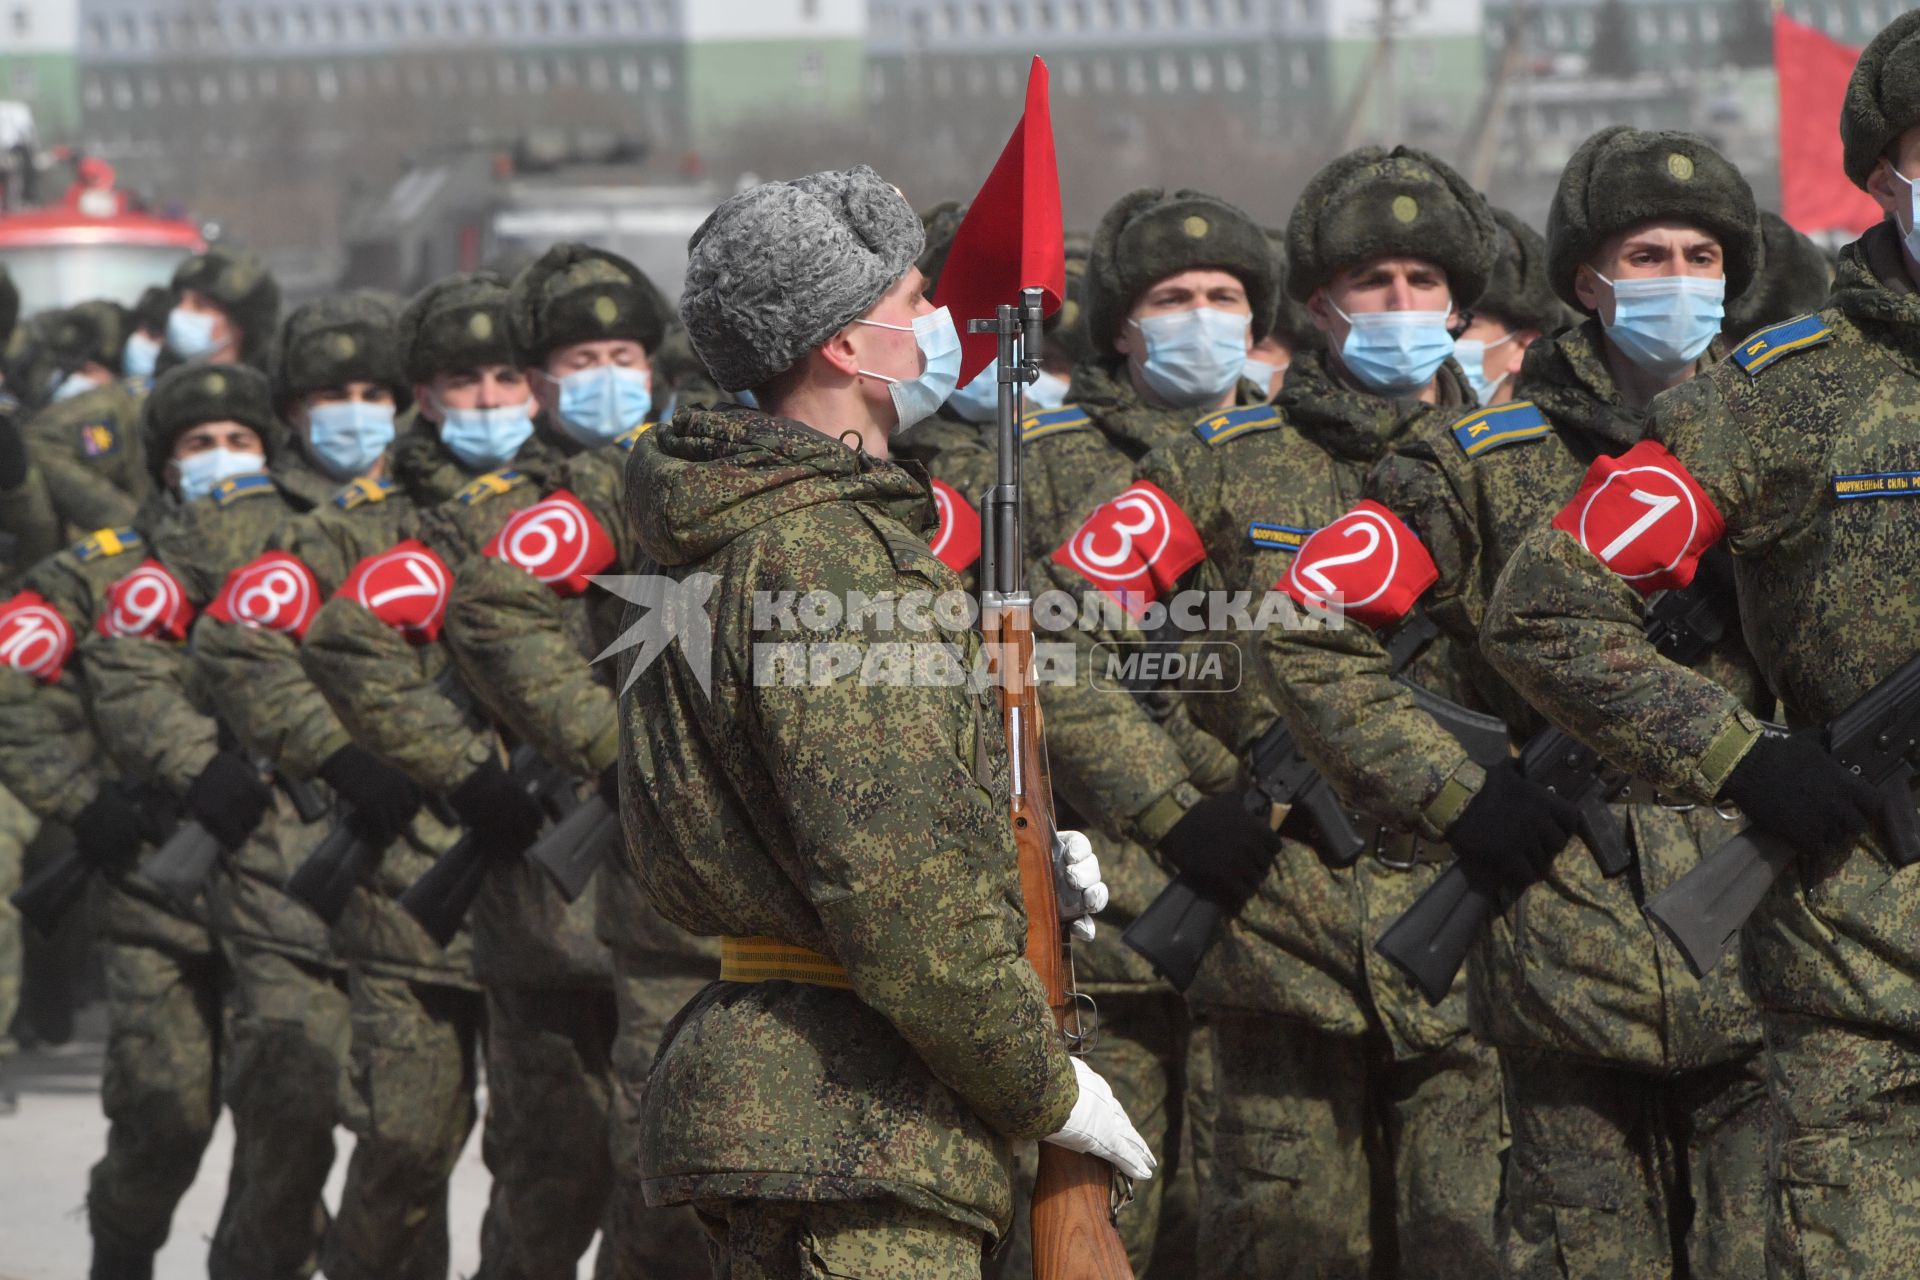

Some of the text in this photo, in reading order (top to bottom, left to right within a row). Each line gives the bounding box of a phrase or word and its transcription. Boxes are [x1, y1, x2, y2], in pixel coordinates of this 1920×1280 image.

[1887, 477, 1908, 490] СИЛЫ
[509, 507, 578, 567] 6
[1081, 497, 1156, 568] 3
[1600, 488, 1681, 563] 1
[1300, 521, 1380, 596] 2
[112, 575, 168, 634] 9
[238, 569, 298, 624] 8
[0, 616, 59, 674] 10
